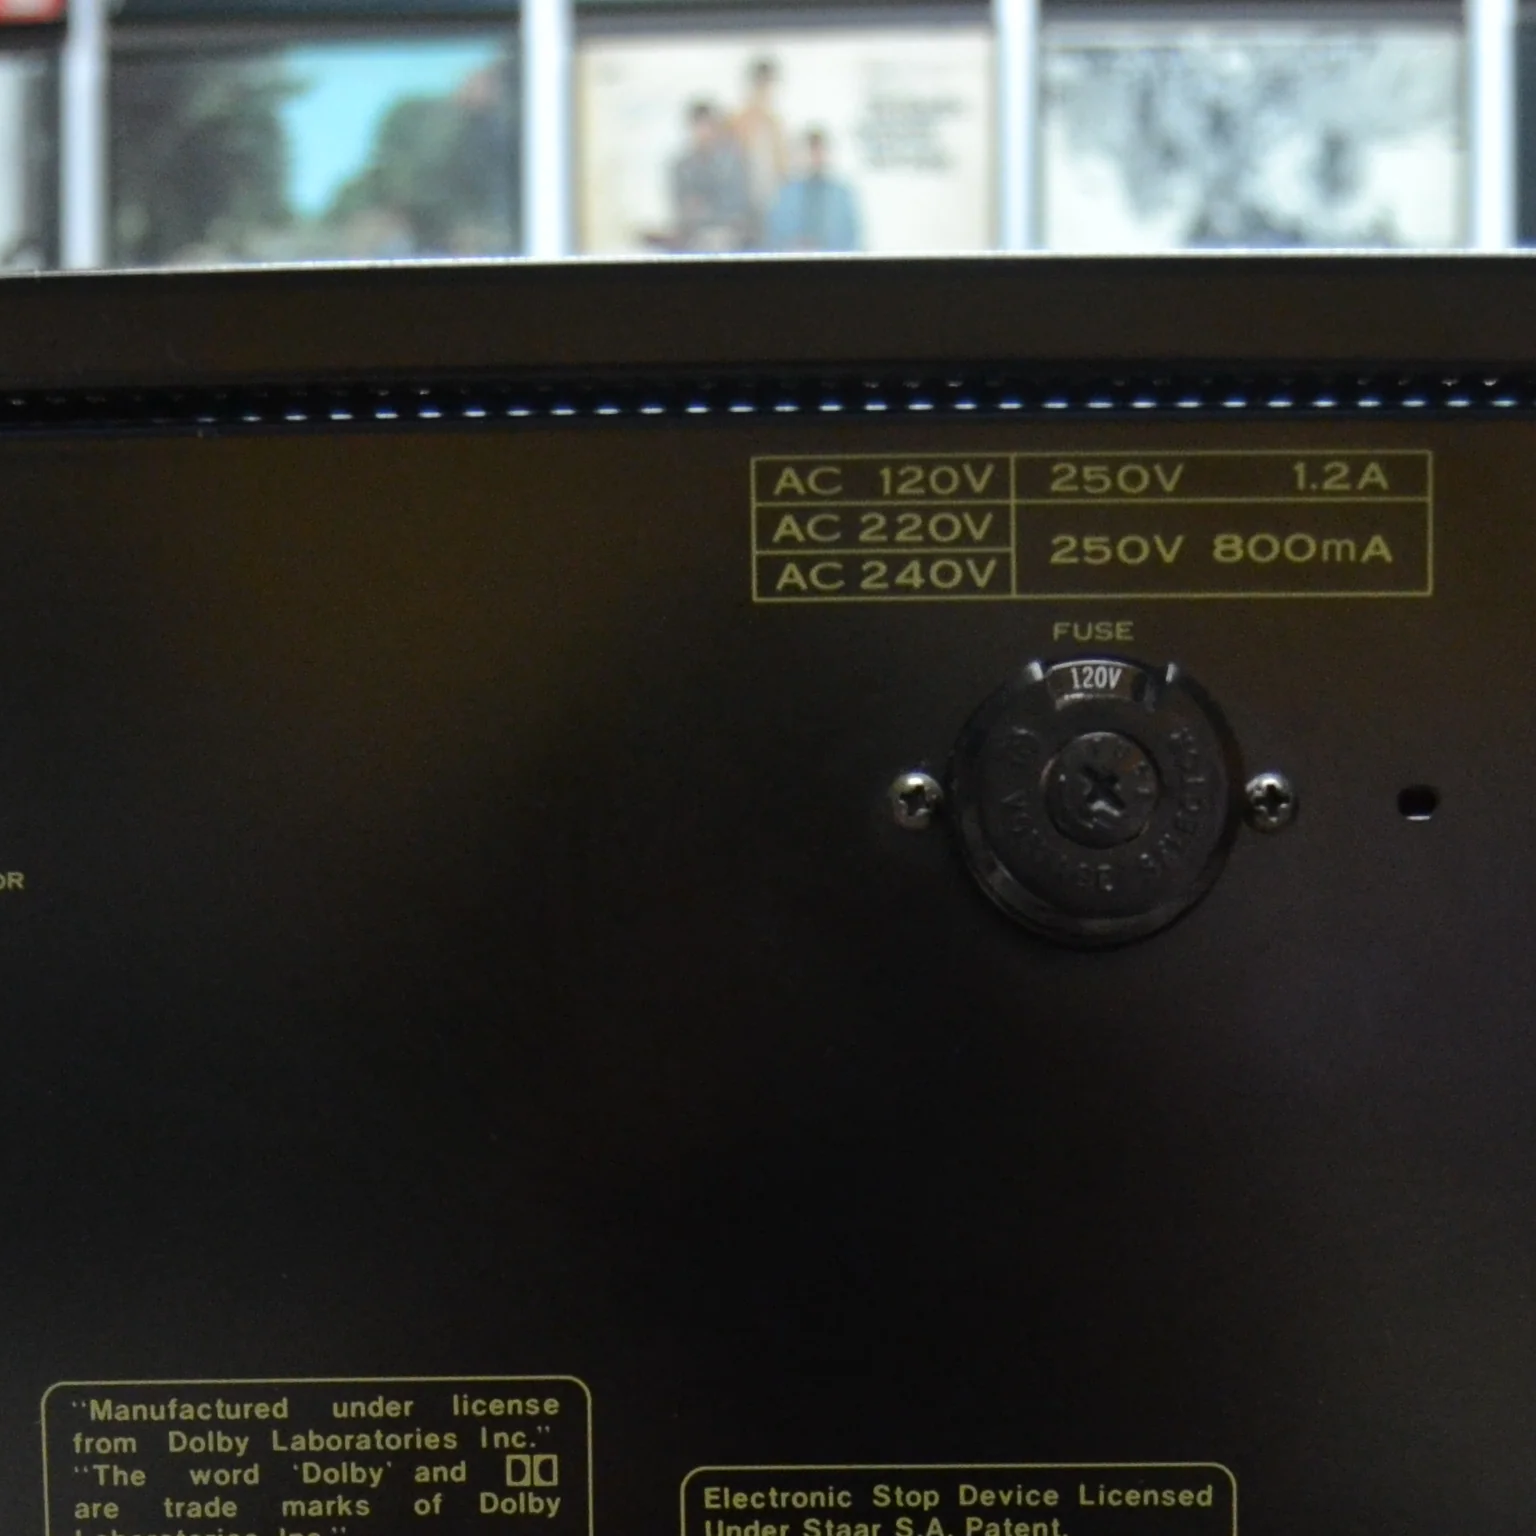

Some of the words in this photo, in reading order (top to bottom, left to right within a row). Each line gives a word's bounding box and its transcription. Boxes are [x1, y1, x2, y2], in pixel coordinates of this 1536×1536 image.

[773, 466, 843, 497] AC
[878, 463, 995, 496] 120V
[1050, 462, 1184, 493] 250V
[1292, 459, 1390, 492] 1.2A
[772, 514, 841, 544] AC
[858, 512, 993, 543] 220V
[1050, 535, 1185, 566] 250V
[1212, 532, 1393, 565] 800mA
[776, 561, 845, 592] AC
[860, 559, 996, 590] 240V
[1052, 621, 1135, 643] FUSE
[1070, 666, 1122, 691] 120V
[331, 1395, 415, 1419] under
[451, 1393, 561, 1417] license
[72, 1431, 138, 1455] from
[168, 1429, 250, 1457] Dolby
[271, 1427, 459, 1453] Laboratories
[189, 1463, 261, 1486] word
[413, 1460, 467, 1484] and
[73, 1499, 120, 1520] are
[164, 1496, 238, 1519] trade
[281, 1494, 372, 1518] marks
[413, 1493, 444, 1516] of
[479, 1492, 562, 1518] Dolby
[703, 1486, 853, 1510] Electronic
[872, 1485, 941, 1511] Stop
[958, 1484, 1061, 1508] Device
[1078, 1483, 1214, 1508] Licensed
